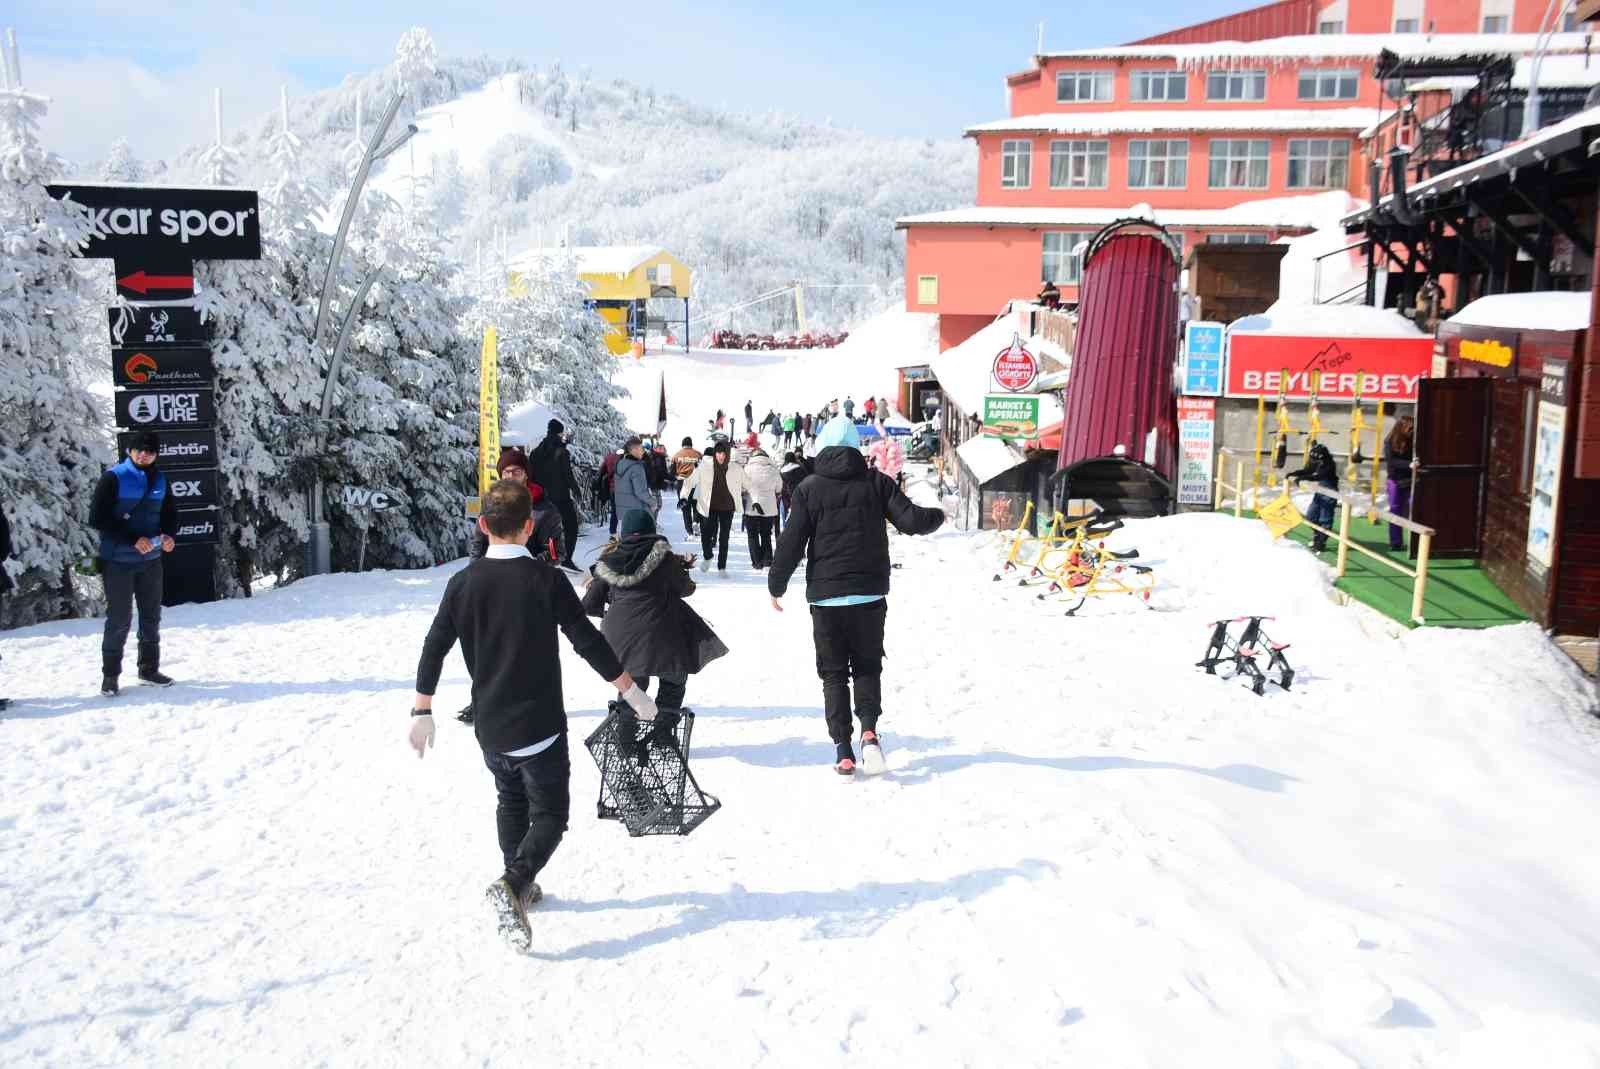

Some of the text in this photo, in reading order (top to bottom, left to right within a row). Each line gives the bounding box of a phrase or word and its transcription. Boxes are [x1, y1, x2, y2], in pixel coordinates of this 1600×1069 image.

[87, 207, 249, 243] kar spor
[1319, 351, 1352, 371] Tepe
[160, 394, 199, 408] PICT
[988, 401, 1025, 409] MARKET
[160, 408, 198, 422] URE
[171, 480, 202, 497] ex
[343, 486, 389, 509] WC
